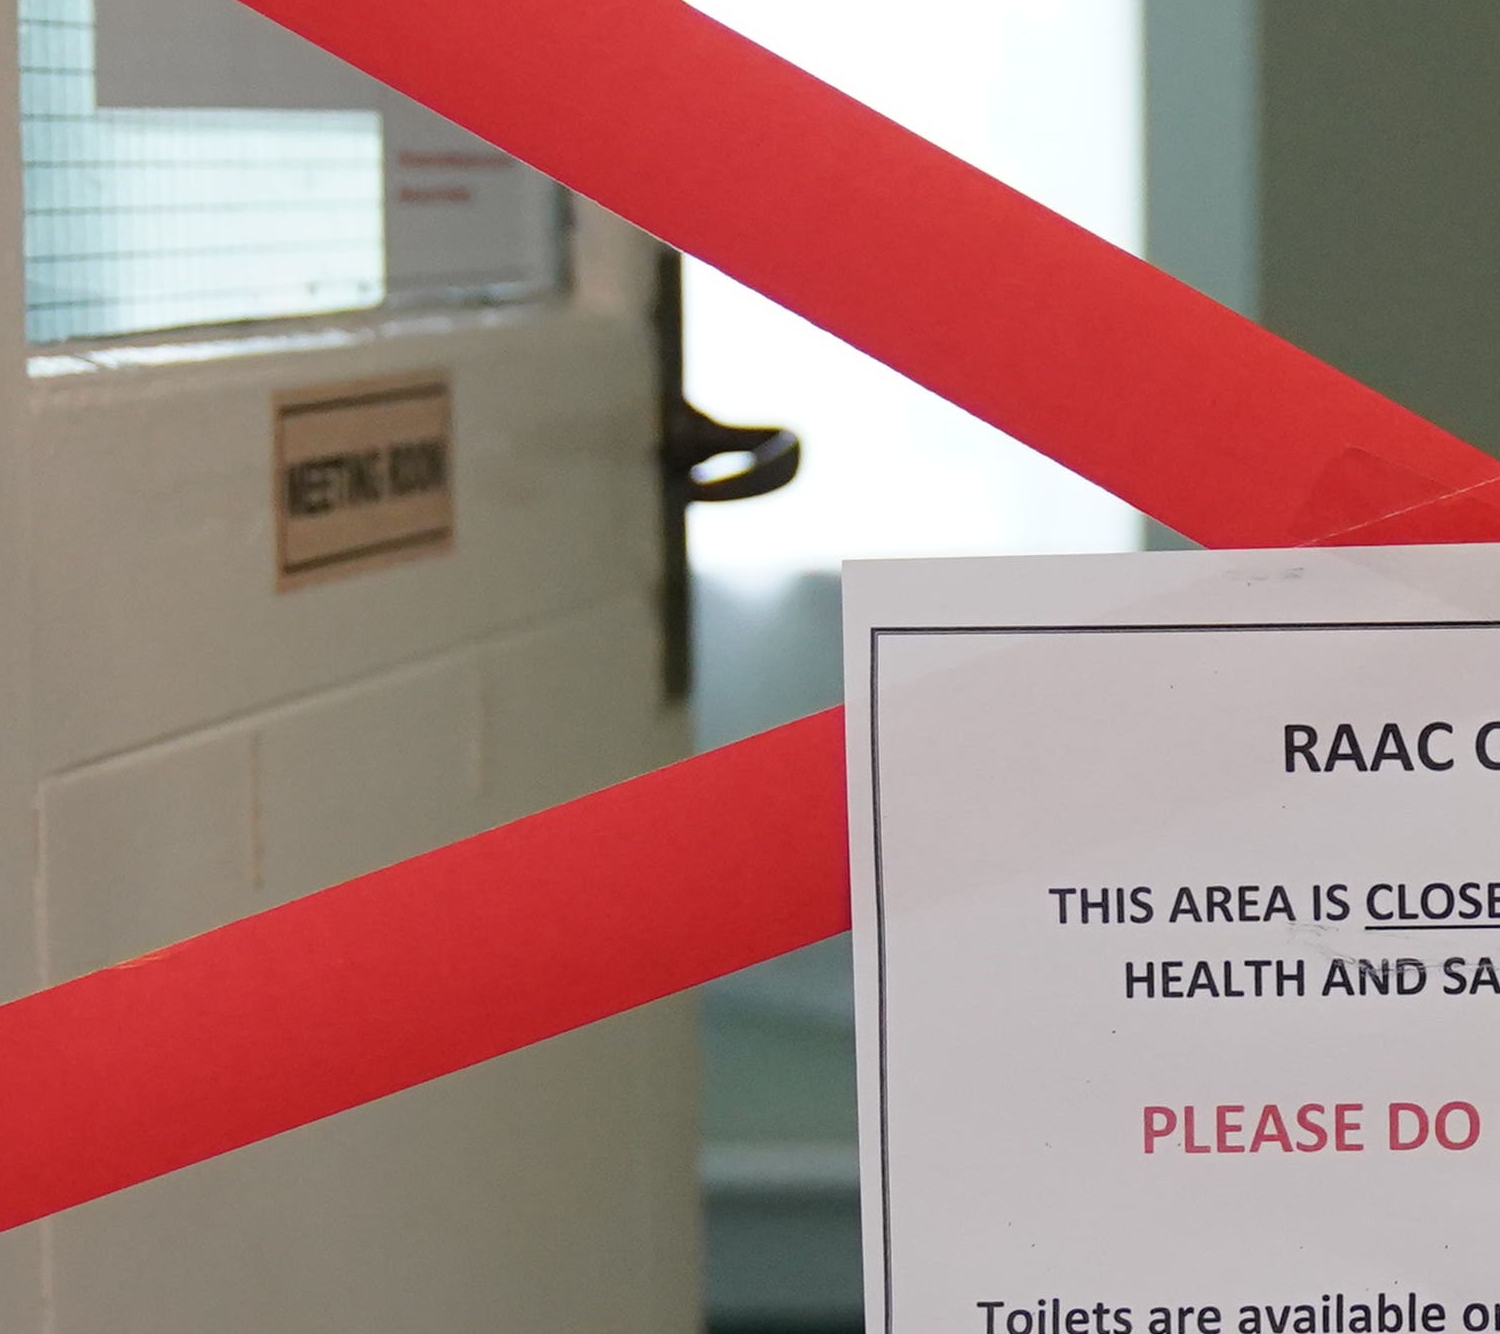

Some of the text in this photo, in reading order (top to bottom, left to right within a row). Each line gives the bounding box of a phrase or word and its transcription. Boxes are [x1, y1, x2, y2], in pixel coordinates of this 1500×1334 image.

[1283, 721, 1455, 774] RAAC
[1047, 885, 1155, 926] THIS
[1167, 884, 1298, 924] AREA
[1311, 882, 1352, 923] IS
[1124, 957, 1306, 1000] HEALTH
[1320, 956, 1428, 998] AND
[1142, 1102, 1365, 1155] PLEASE
[1387, 1100, 1482, 1152] DO
